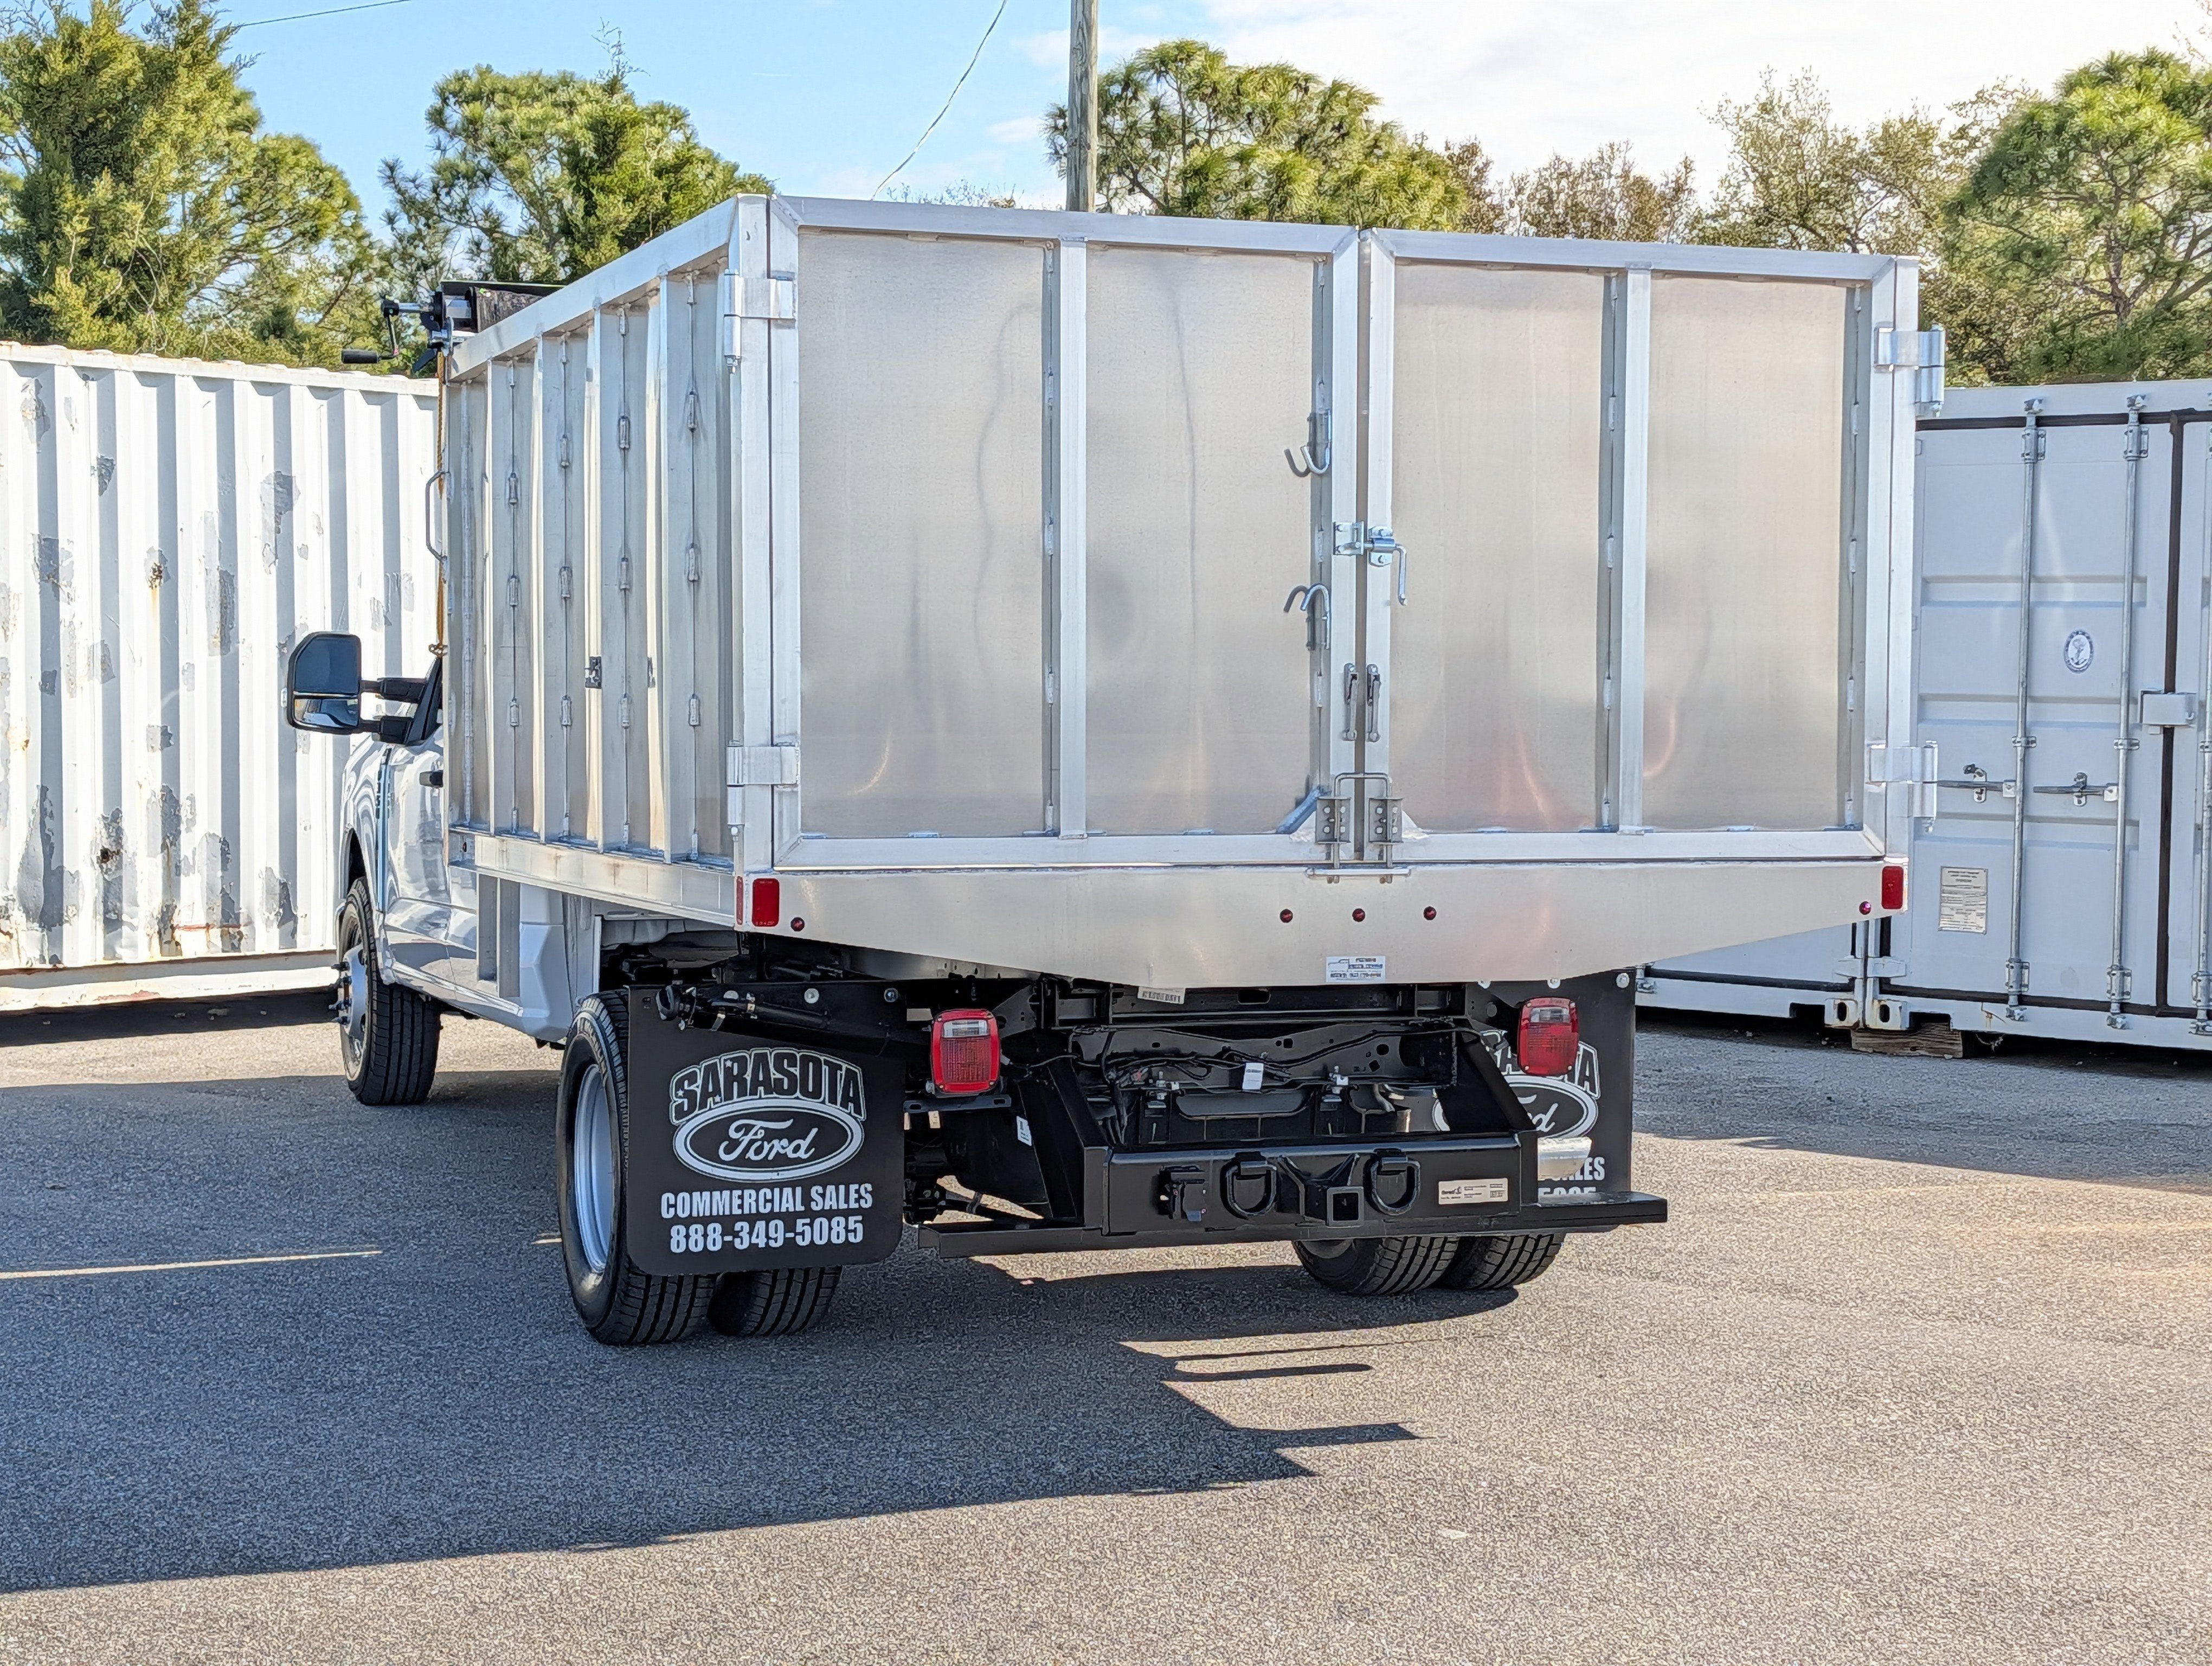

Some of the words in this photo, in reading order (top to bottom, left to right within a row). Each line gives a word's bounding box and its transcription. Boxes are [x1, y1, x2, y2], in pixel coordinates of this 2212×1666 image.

[669, 1047, 866, 1125] SARASOTA
[718, 1118, 818, 1161] Ford
[661, 1186, 805, 1219] COMMERCIAL
[811, 1183, 873, 1210] SALES
[670, 1216, 863, 1253] 888-349-5085
